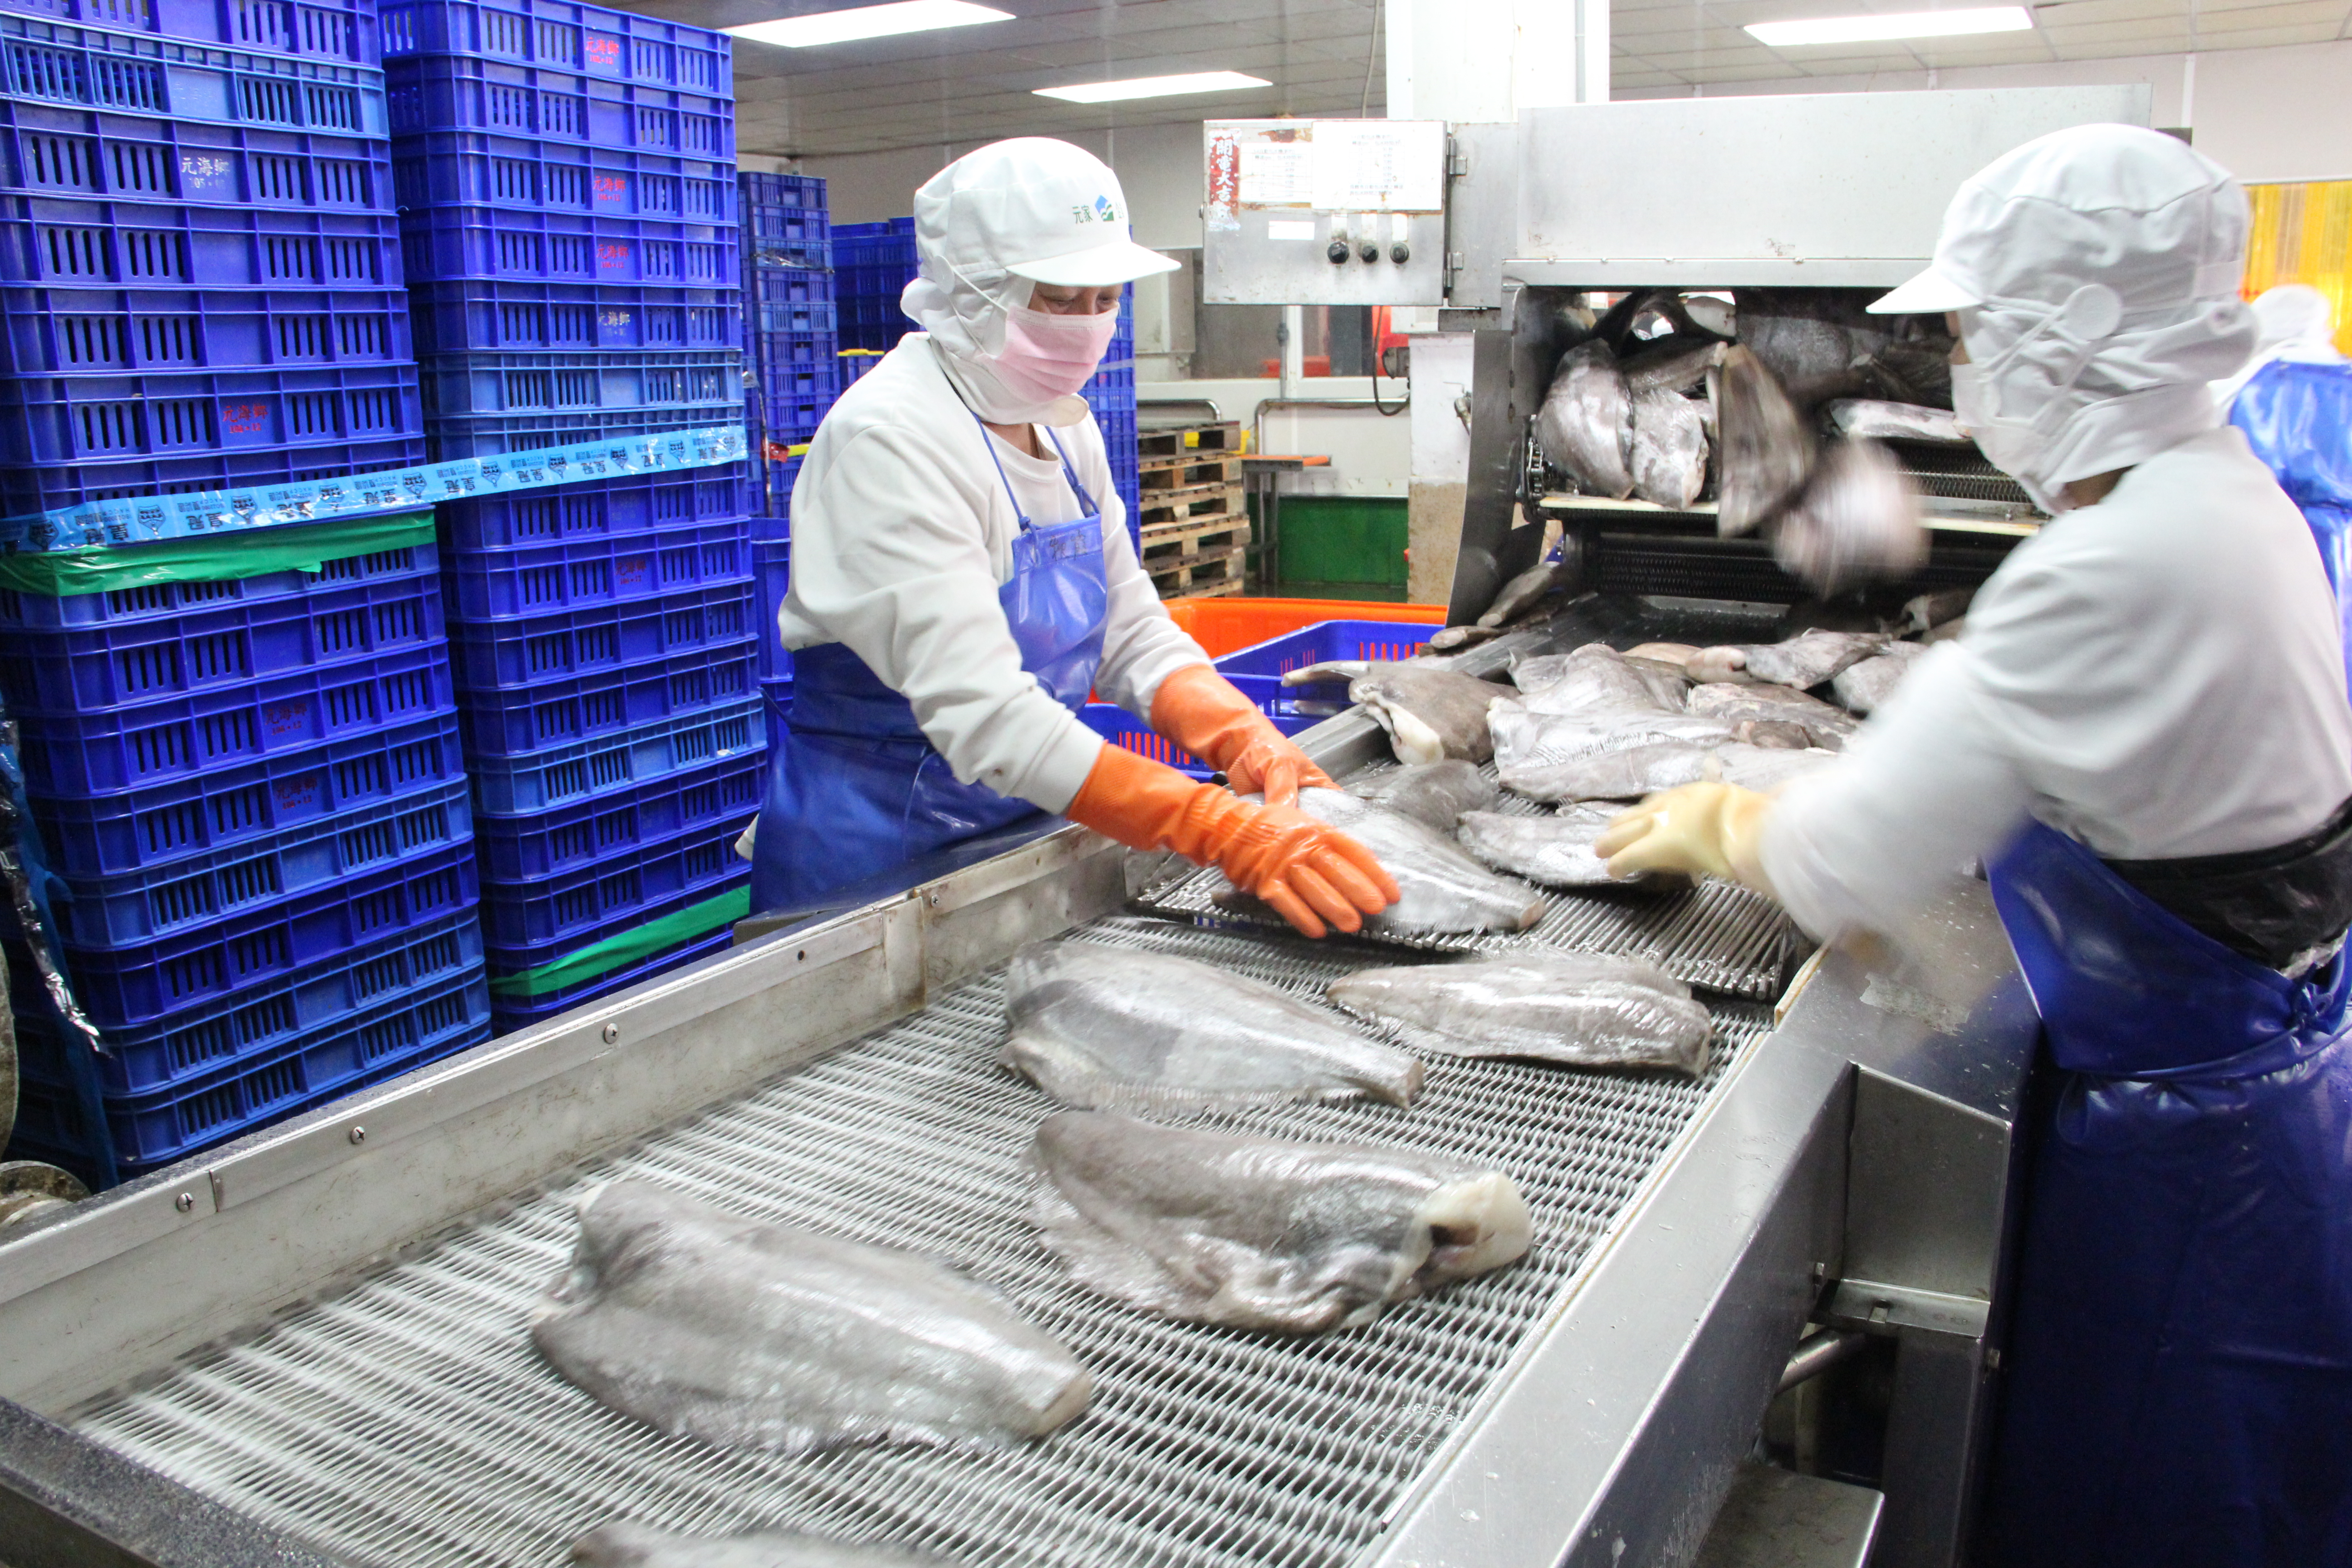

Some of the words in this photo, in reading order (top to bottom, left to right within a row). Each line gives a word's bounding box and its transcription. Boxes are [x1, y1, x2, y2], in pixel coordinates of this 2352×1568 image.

[181, 157, 230, 176] 元海鄉
[1072, 205, 1093, 224] 元家
[222, 403, 268, 422] 元海鄉
[516, 468, 543, 482] 皇冠
[580, 460, 605, 474] 皇冠
[444, 477, 475, 493] 皇冠
[363, 489, 395, 505] 皇冠
[186, 511, 222, 530] 皇冠
[83, 523, 128, 544] 皇冠
